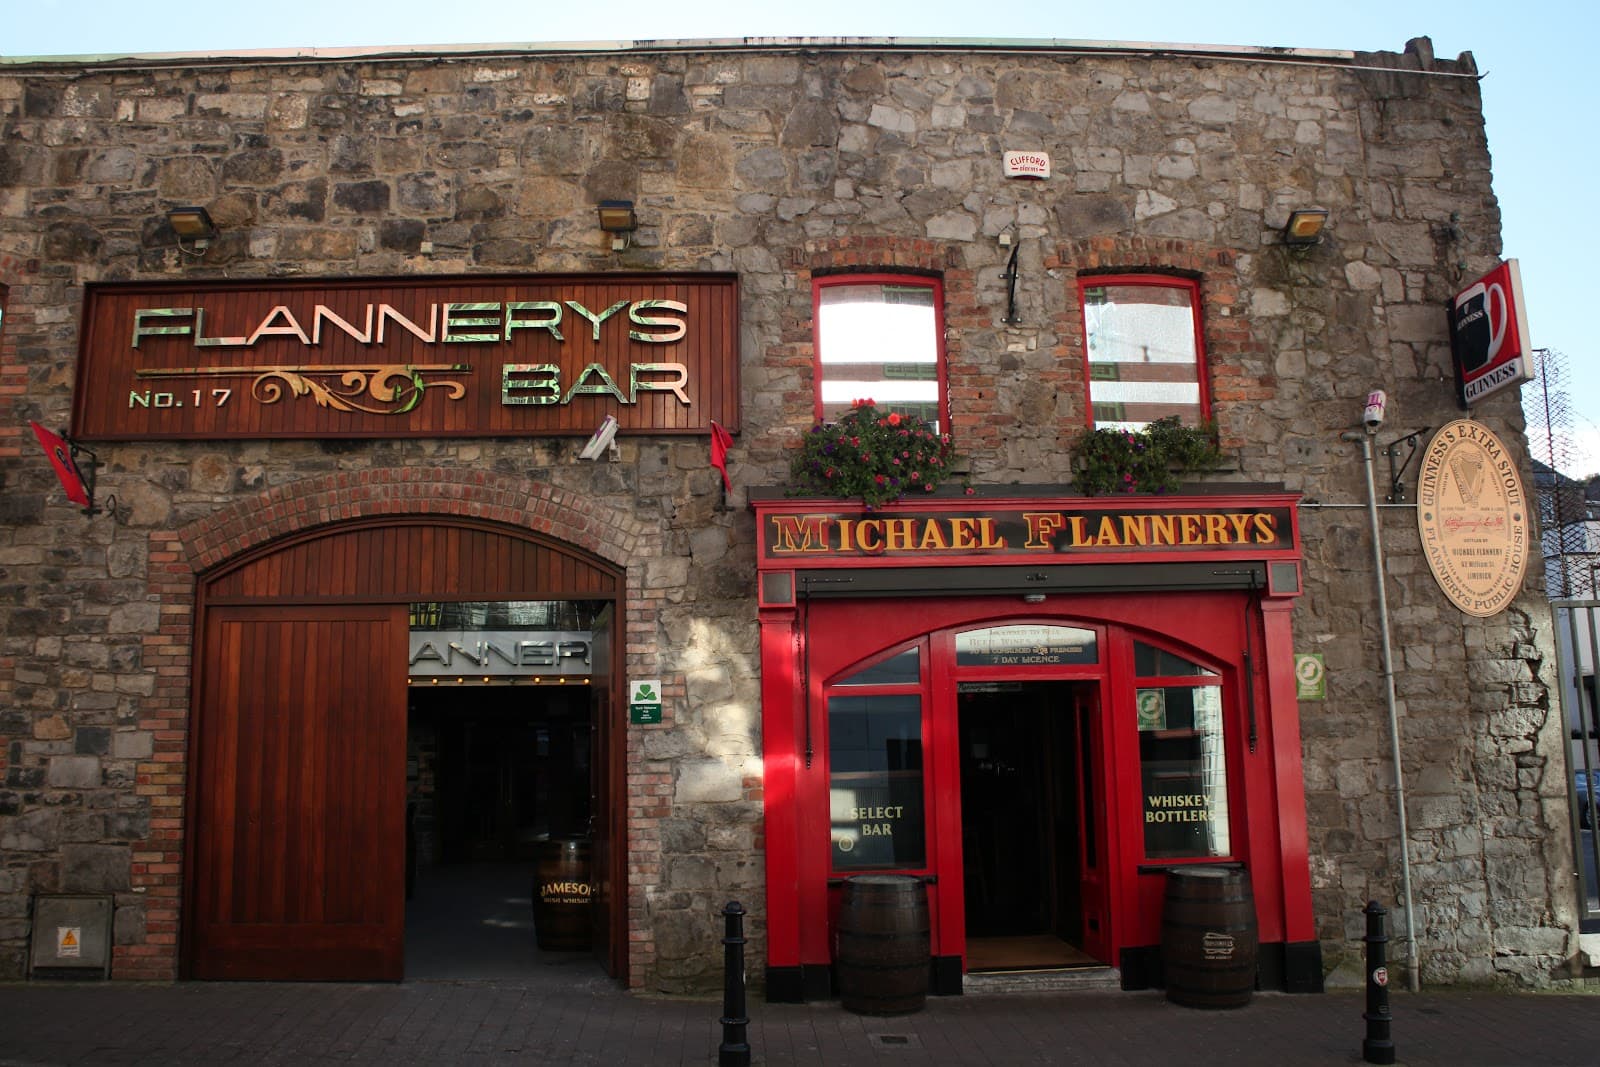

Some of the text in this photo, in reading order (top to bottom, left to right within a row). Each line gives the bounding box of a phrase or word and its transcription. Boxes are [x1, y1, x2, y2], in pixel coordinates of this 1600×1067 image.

[1010, 155, 1046, 167] CLIFFORD
[131, 299, 688, 348] FLANNERYS
[502, 363, 691, 405] BAR
[1465, 363, 1516, 398] GUINNESS
[128, 388, 231, 408] No. 17
[1422, 430, 1456, 507] GUINNESS'S
[1457, 425, 1501, 460] EXTRA
[1498, 460, 1521, 507] STOUT
[772, 512, 1277, 552] MICHAEL FLANNERYS
[1426, 527, 1473, 607] FLANNERYS
[1474, 576, 1515, 610] PUBLIC
[1509, 525, 1523, 576] HOUSE
[1001, 656, 1018, 664] DAY
[1021, 655, 1060, 664] LICENCE
[1149, 795, 1211, 808] WHISKEY
[850, 806, 903, 820] SELECT
[1145, 810, 1216, 823] BOTTLERS
[862, 823, 892, 836] BAR
[541, 882, 591, 897] JAMESO
